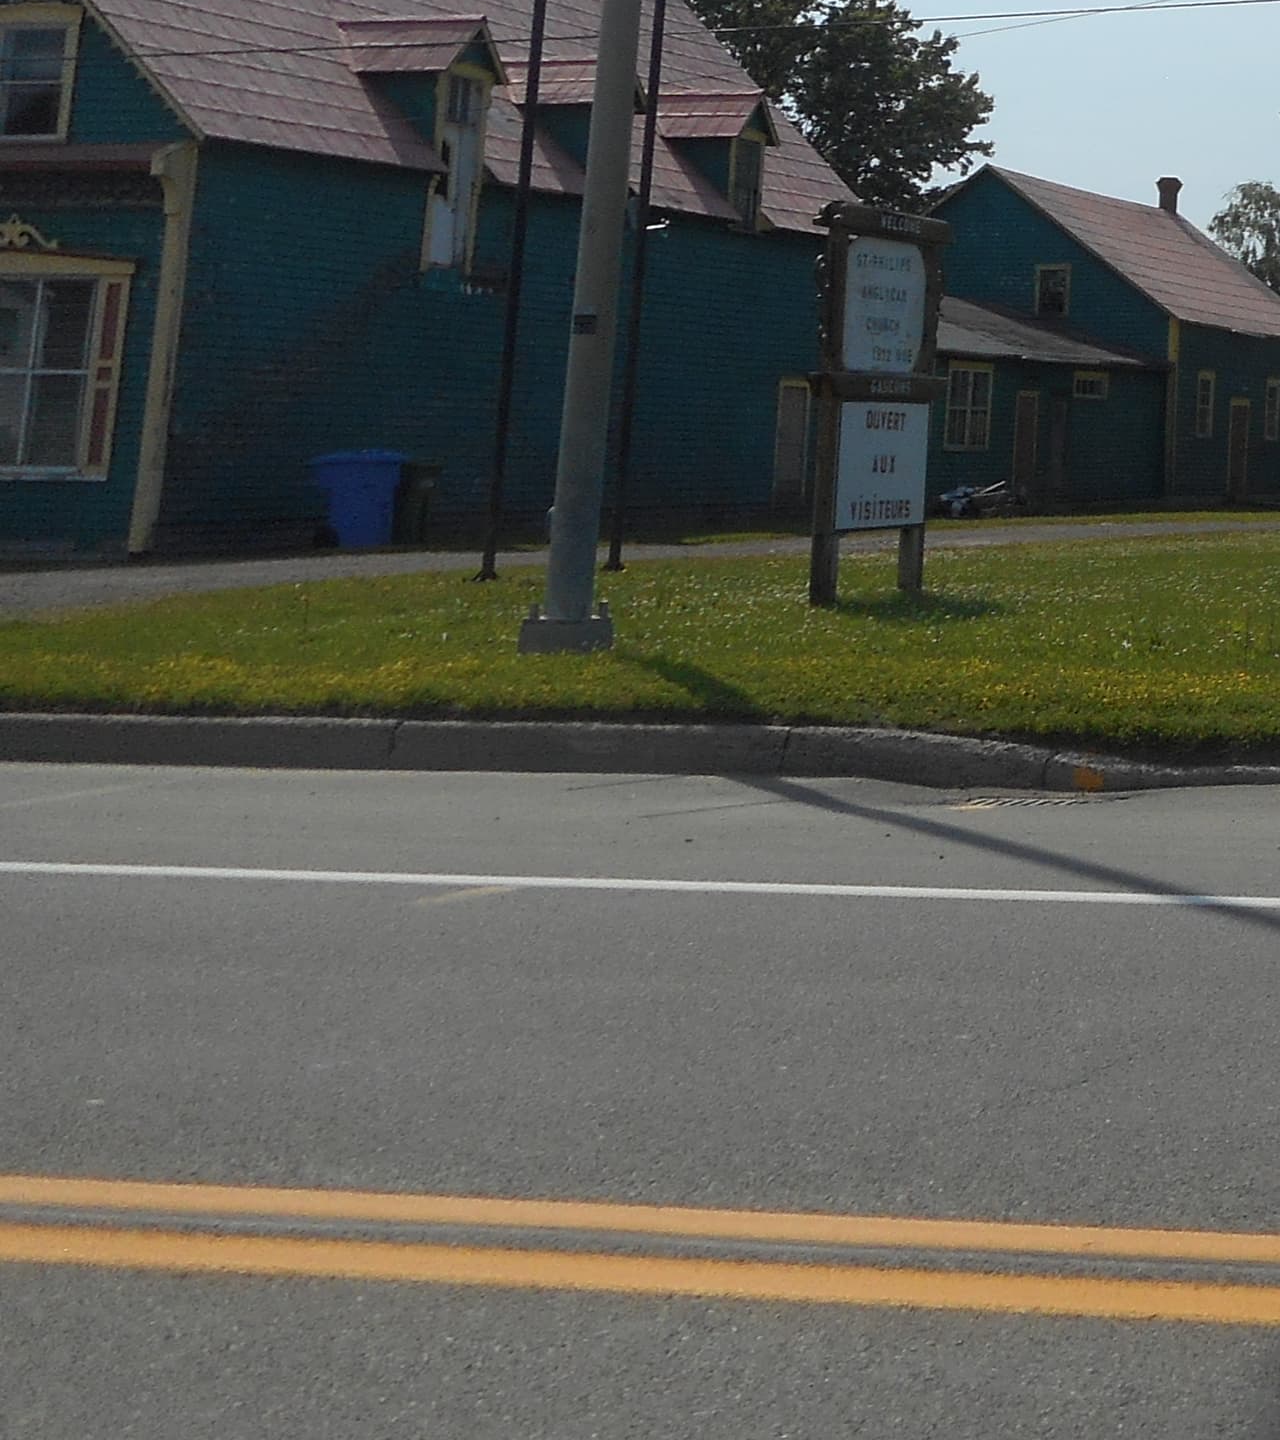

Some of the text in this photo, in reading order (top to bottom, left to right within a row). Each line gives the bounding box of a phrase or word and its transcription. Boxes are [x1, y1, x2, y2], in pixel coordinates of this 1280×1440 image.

[880, 213, 921, 234] WELCOME
[866, 410, 906, 431] OUVERT
[872, 455, 897, 474] AUX
